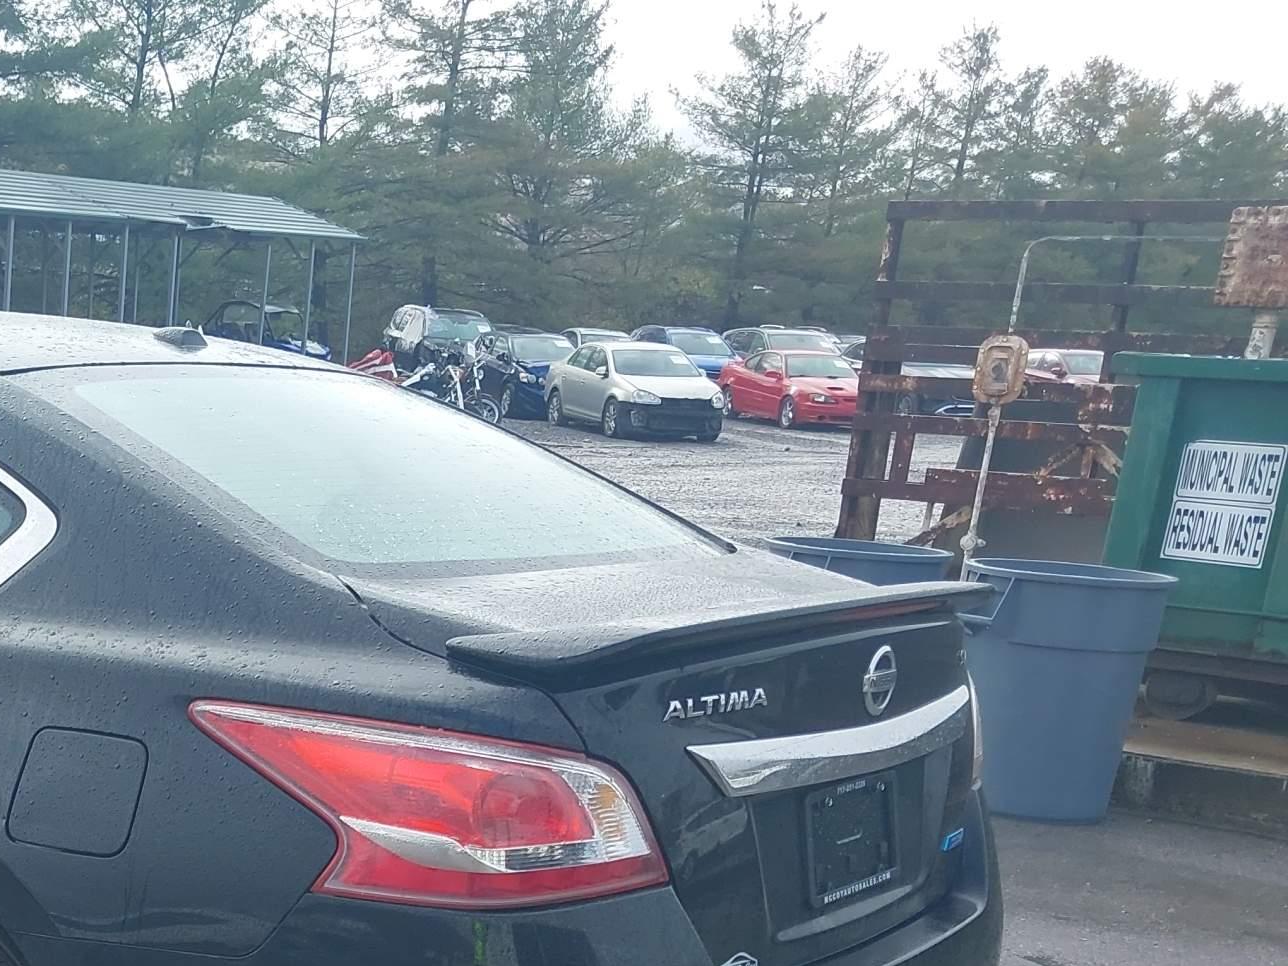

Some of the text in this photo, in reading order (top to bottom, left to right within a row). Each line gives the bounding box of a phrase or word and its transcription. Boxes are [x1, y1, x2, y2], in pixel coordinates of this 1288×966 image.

[1181, 448, 1281, 496] MUNICIPAL WASTE
[1168, 508, 1267, 558] RESIDUAL WASTE
[662, 687, 768, 722] ALTIMA
[823, 871, 891, 904] MCCOYAUTOSALES.COM
